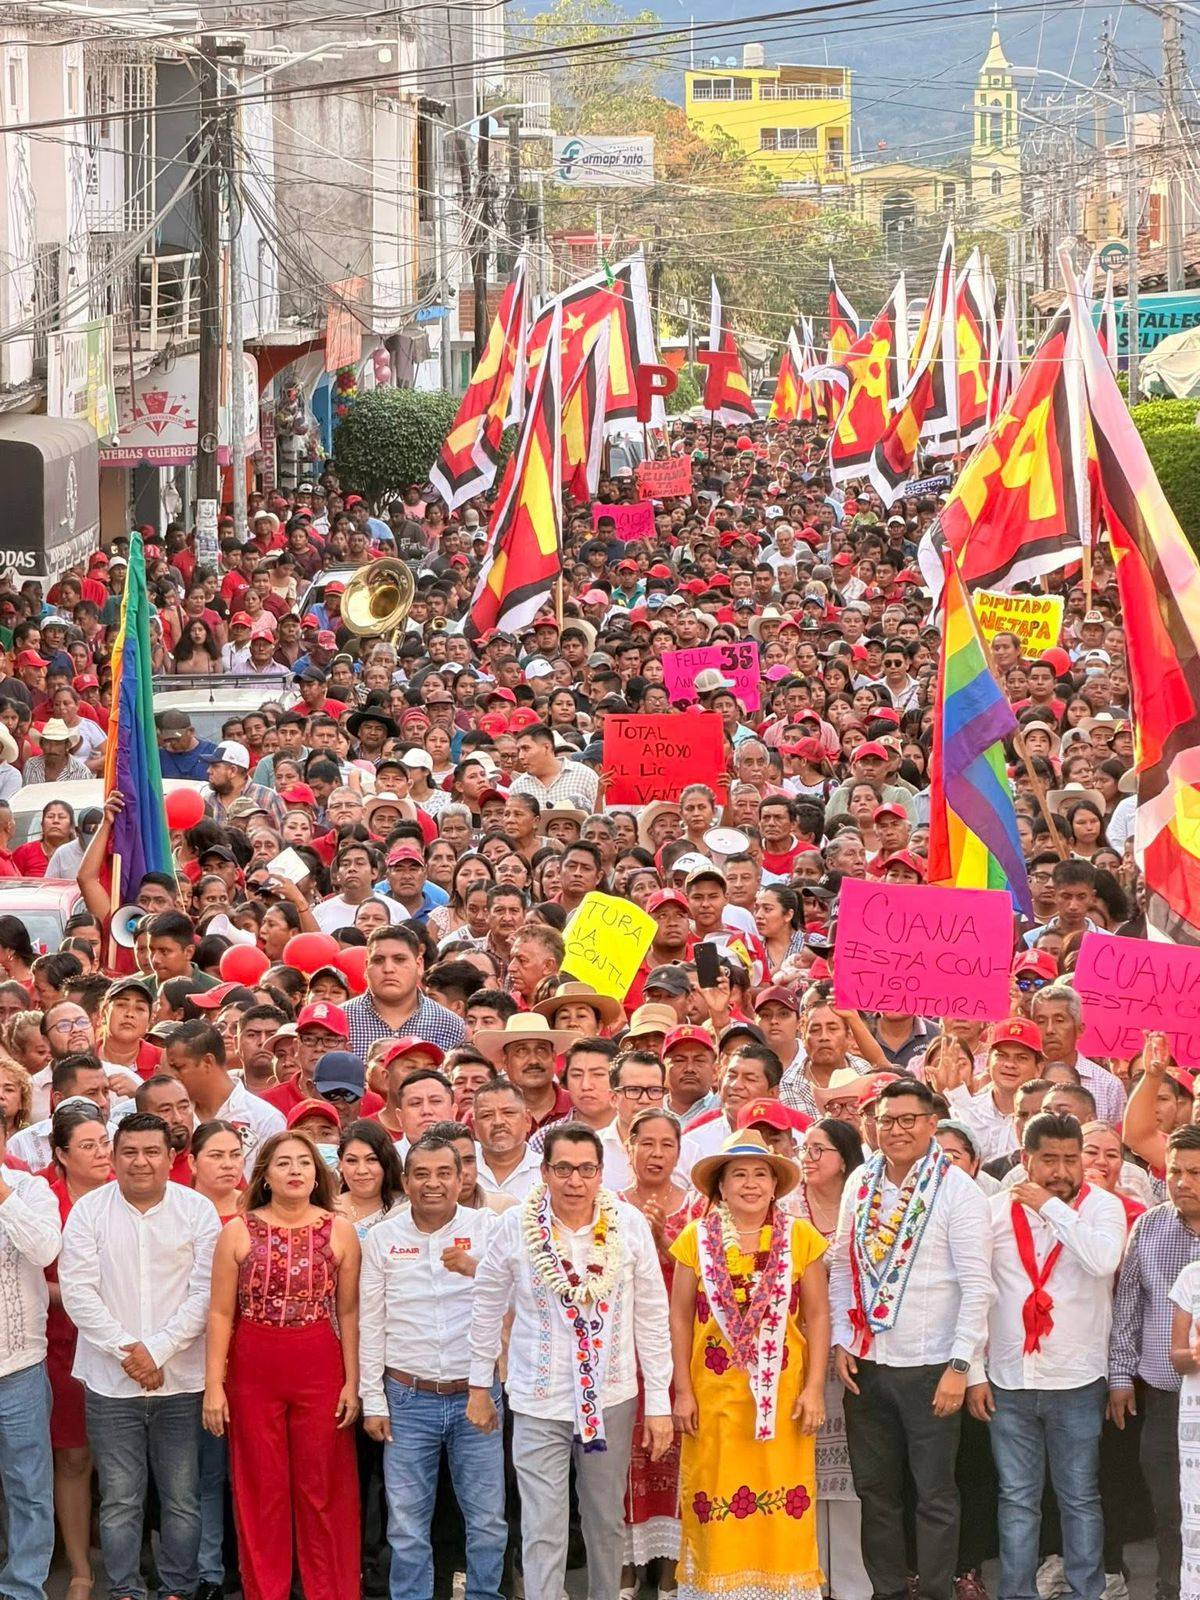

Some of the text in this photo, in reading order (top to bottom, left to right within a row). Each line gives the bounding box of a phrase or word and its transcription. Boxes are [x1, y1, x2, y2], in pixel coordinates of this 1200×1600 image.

[98, 446, 198, 460] ATERIAS GUERRER
[980, 592, 1051, 614] DIPUTADO
[675, 652, 711, 667] FELIZ
[642, 742, 691, 758] APOYO
[634, 782, 684, 804] VENT
[587, 900, 643, 947] TURA
[863, 892, 980, 944] CUANA
[843, 940, 927, 971] ESTA
[851, 970, 921, 992] TIGO
[855, 989, 989, 1018] VENTURA
[1079, 990, 1163, 1016] ESTA
